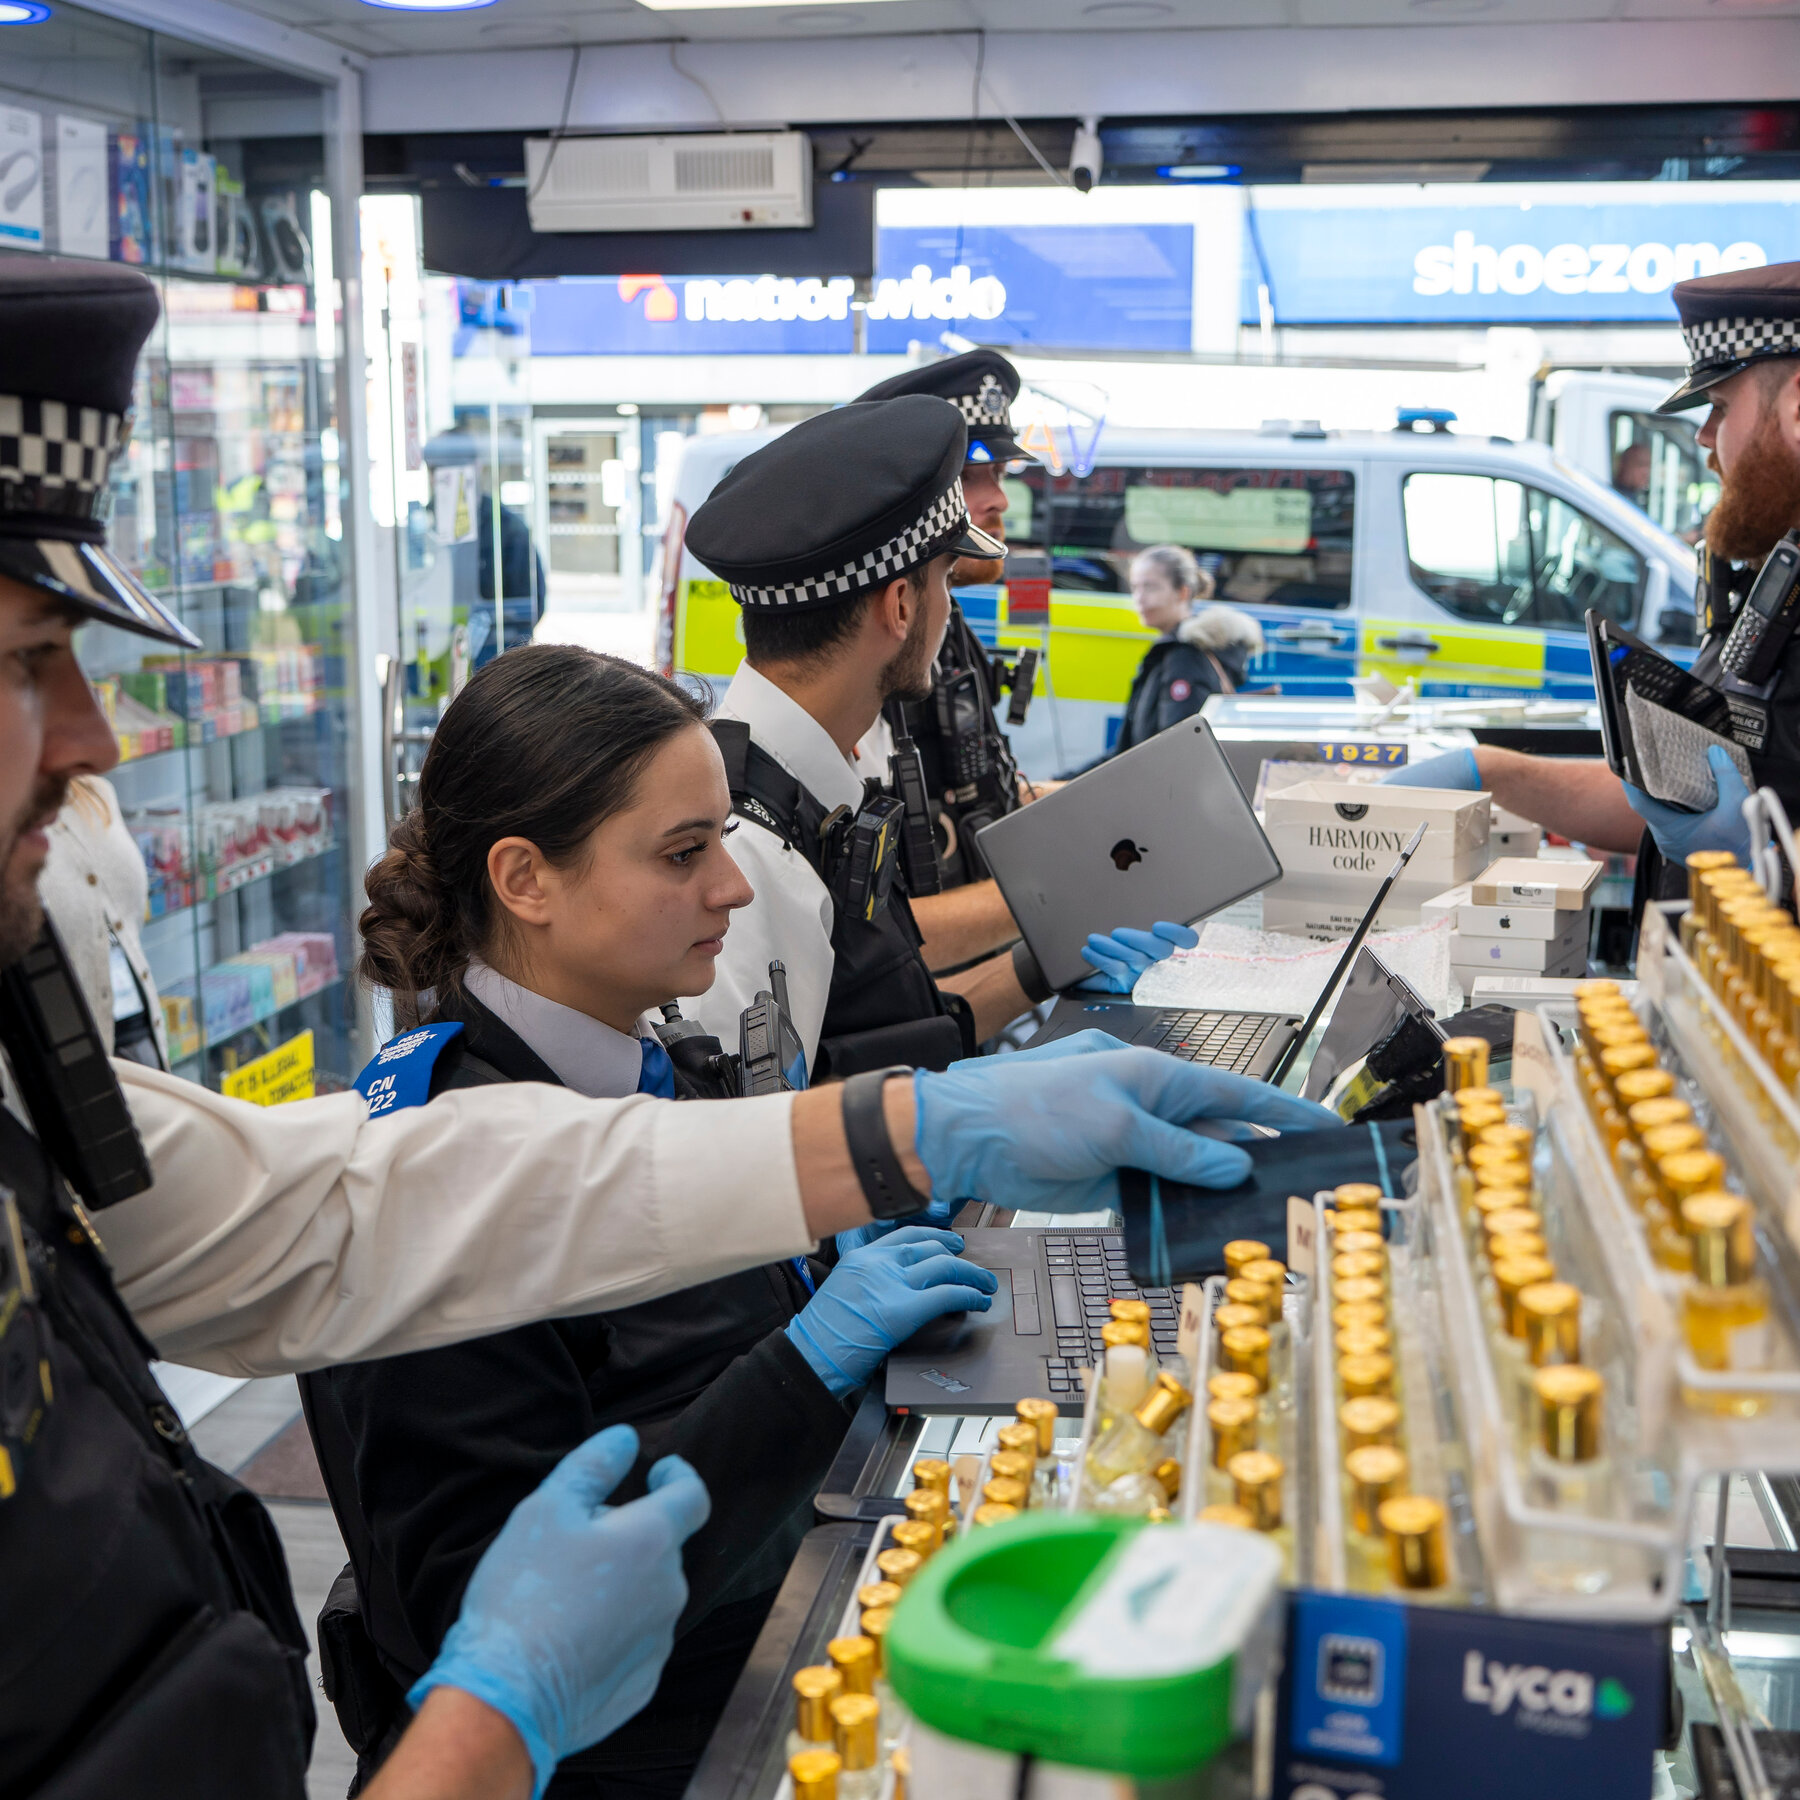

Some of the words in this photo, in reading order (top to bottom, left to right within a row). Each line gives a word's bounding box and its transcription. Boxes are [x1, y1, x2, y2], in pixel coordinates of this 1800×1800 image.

[1322, 745, 1402, 762] 1927
[1308, 826, 1406, 852] HARMONY
[1333, 853, 1375, 872] code
[367, 1074, 396, 1096] CN
[1463, 1650, 1595, 1716] Lyca
